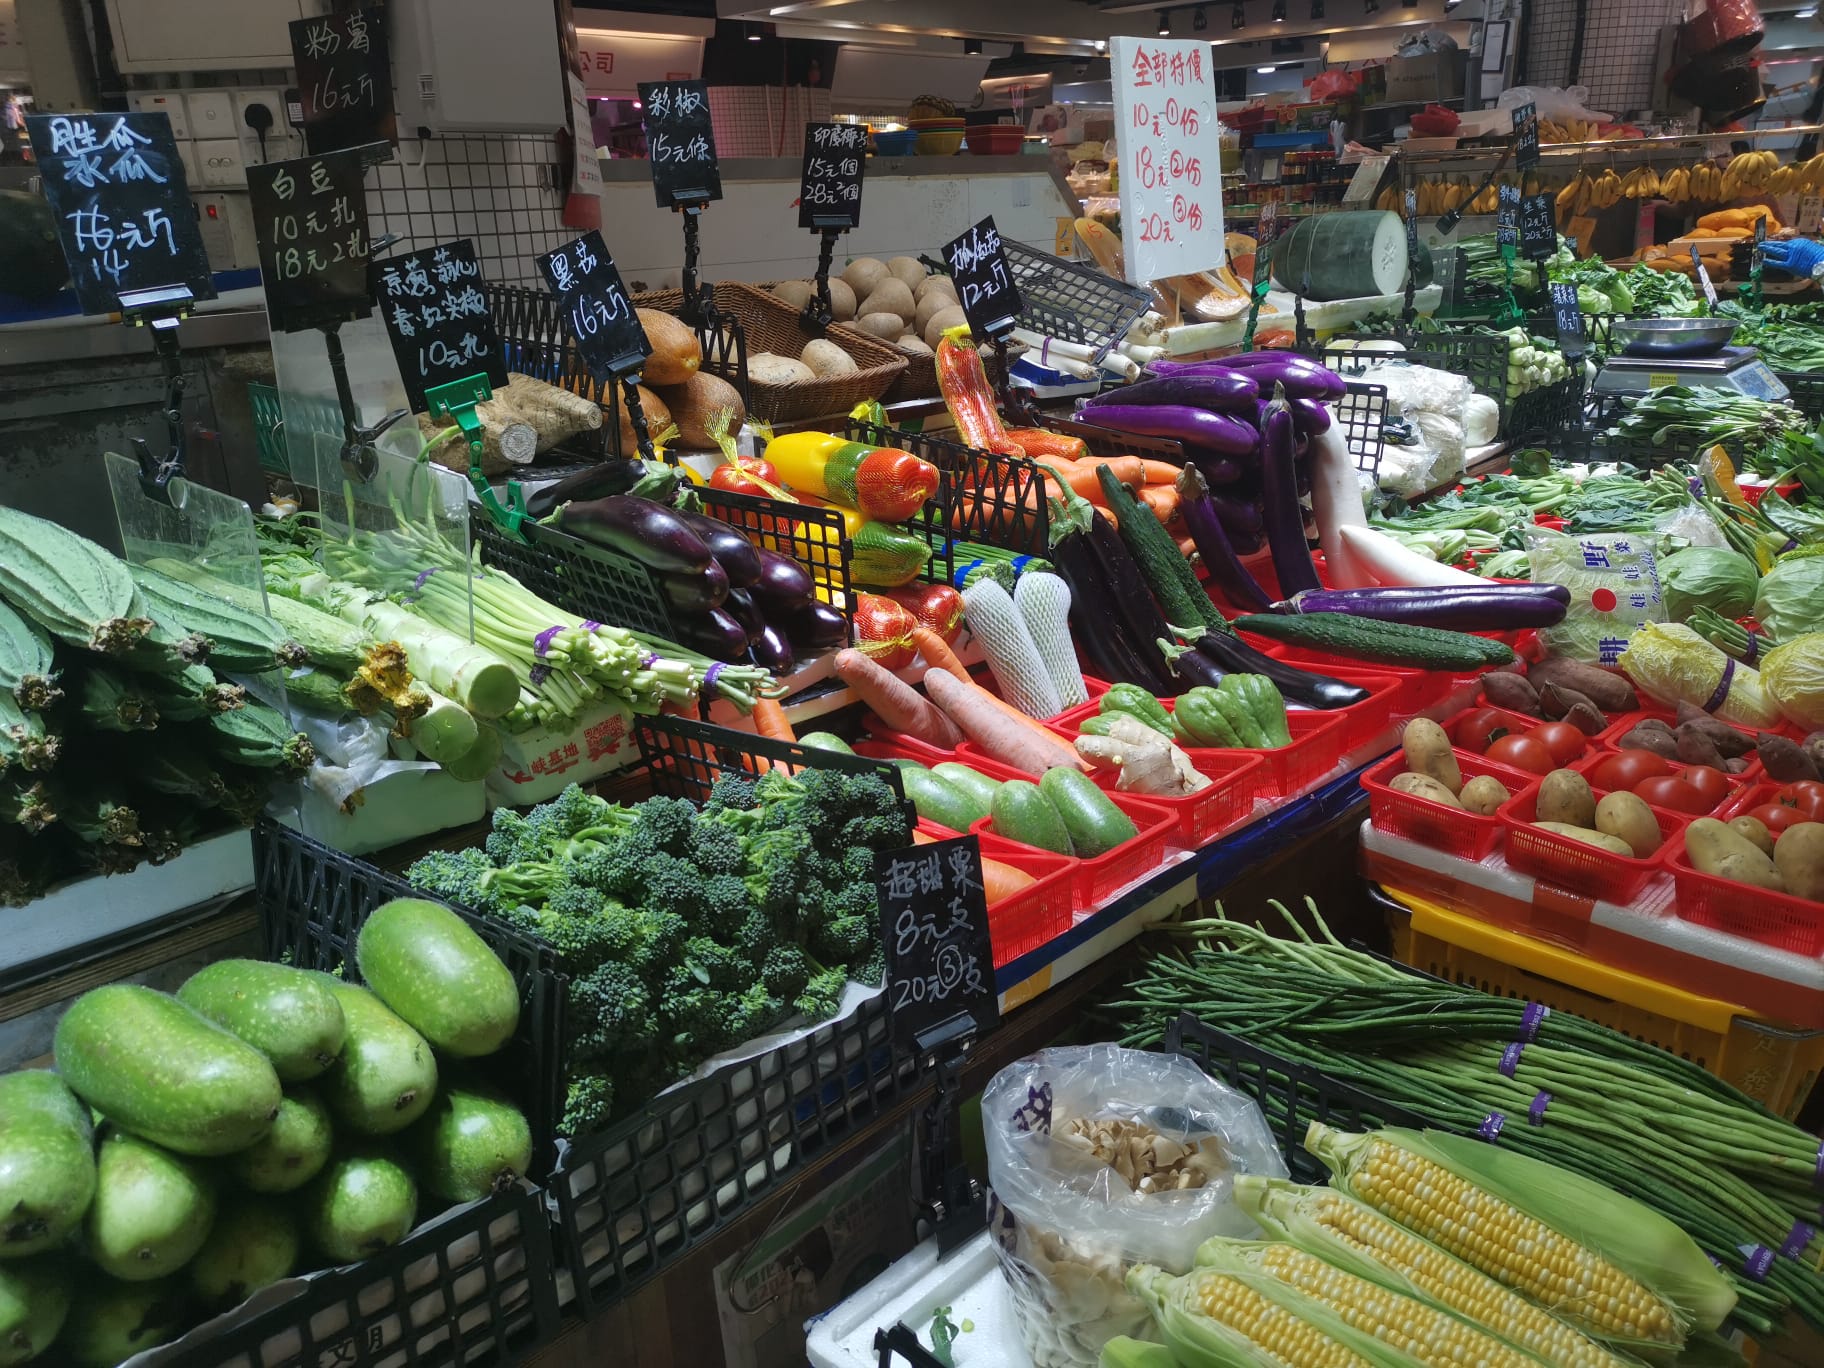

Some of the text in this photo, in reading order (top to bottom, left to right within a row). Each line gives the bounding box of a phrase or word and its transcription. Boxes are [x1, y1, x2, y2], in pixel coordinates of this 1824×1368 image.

[1132, 44, 1204, 88] 全部特價
[272, 161, 335, 200] 白豆
[1579, 541, 1610, 567] 野
[1640, 550, 1662, 604] Vegetable
[895, 896, 975, 955] 8元支
